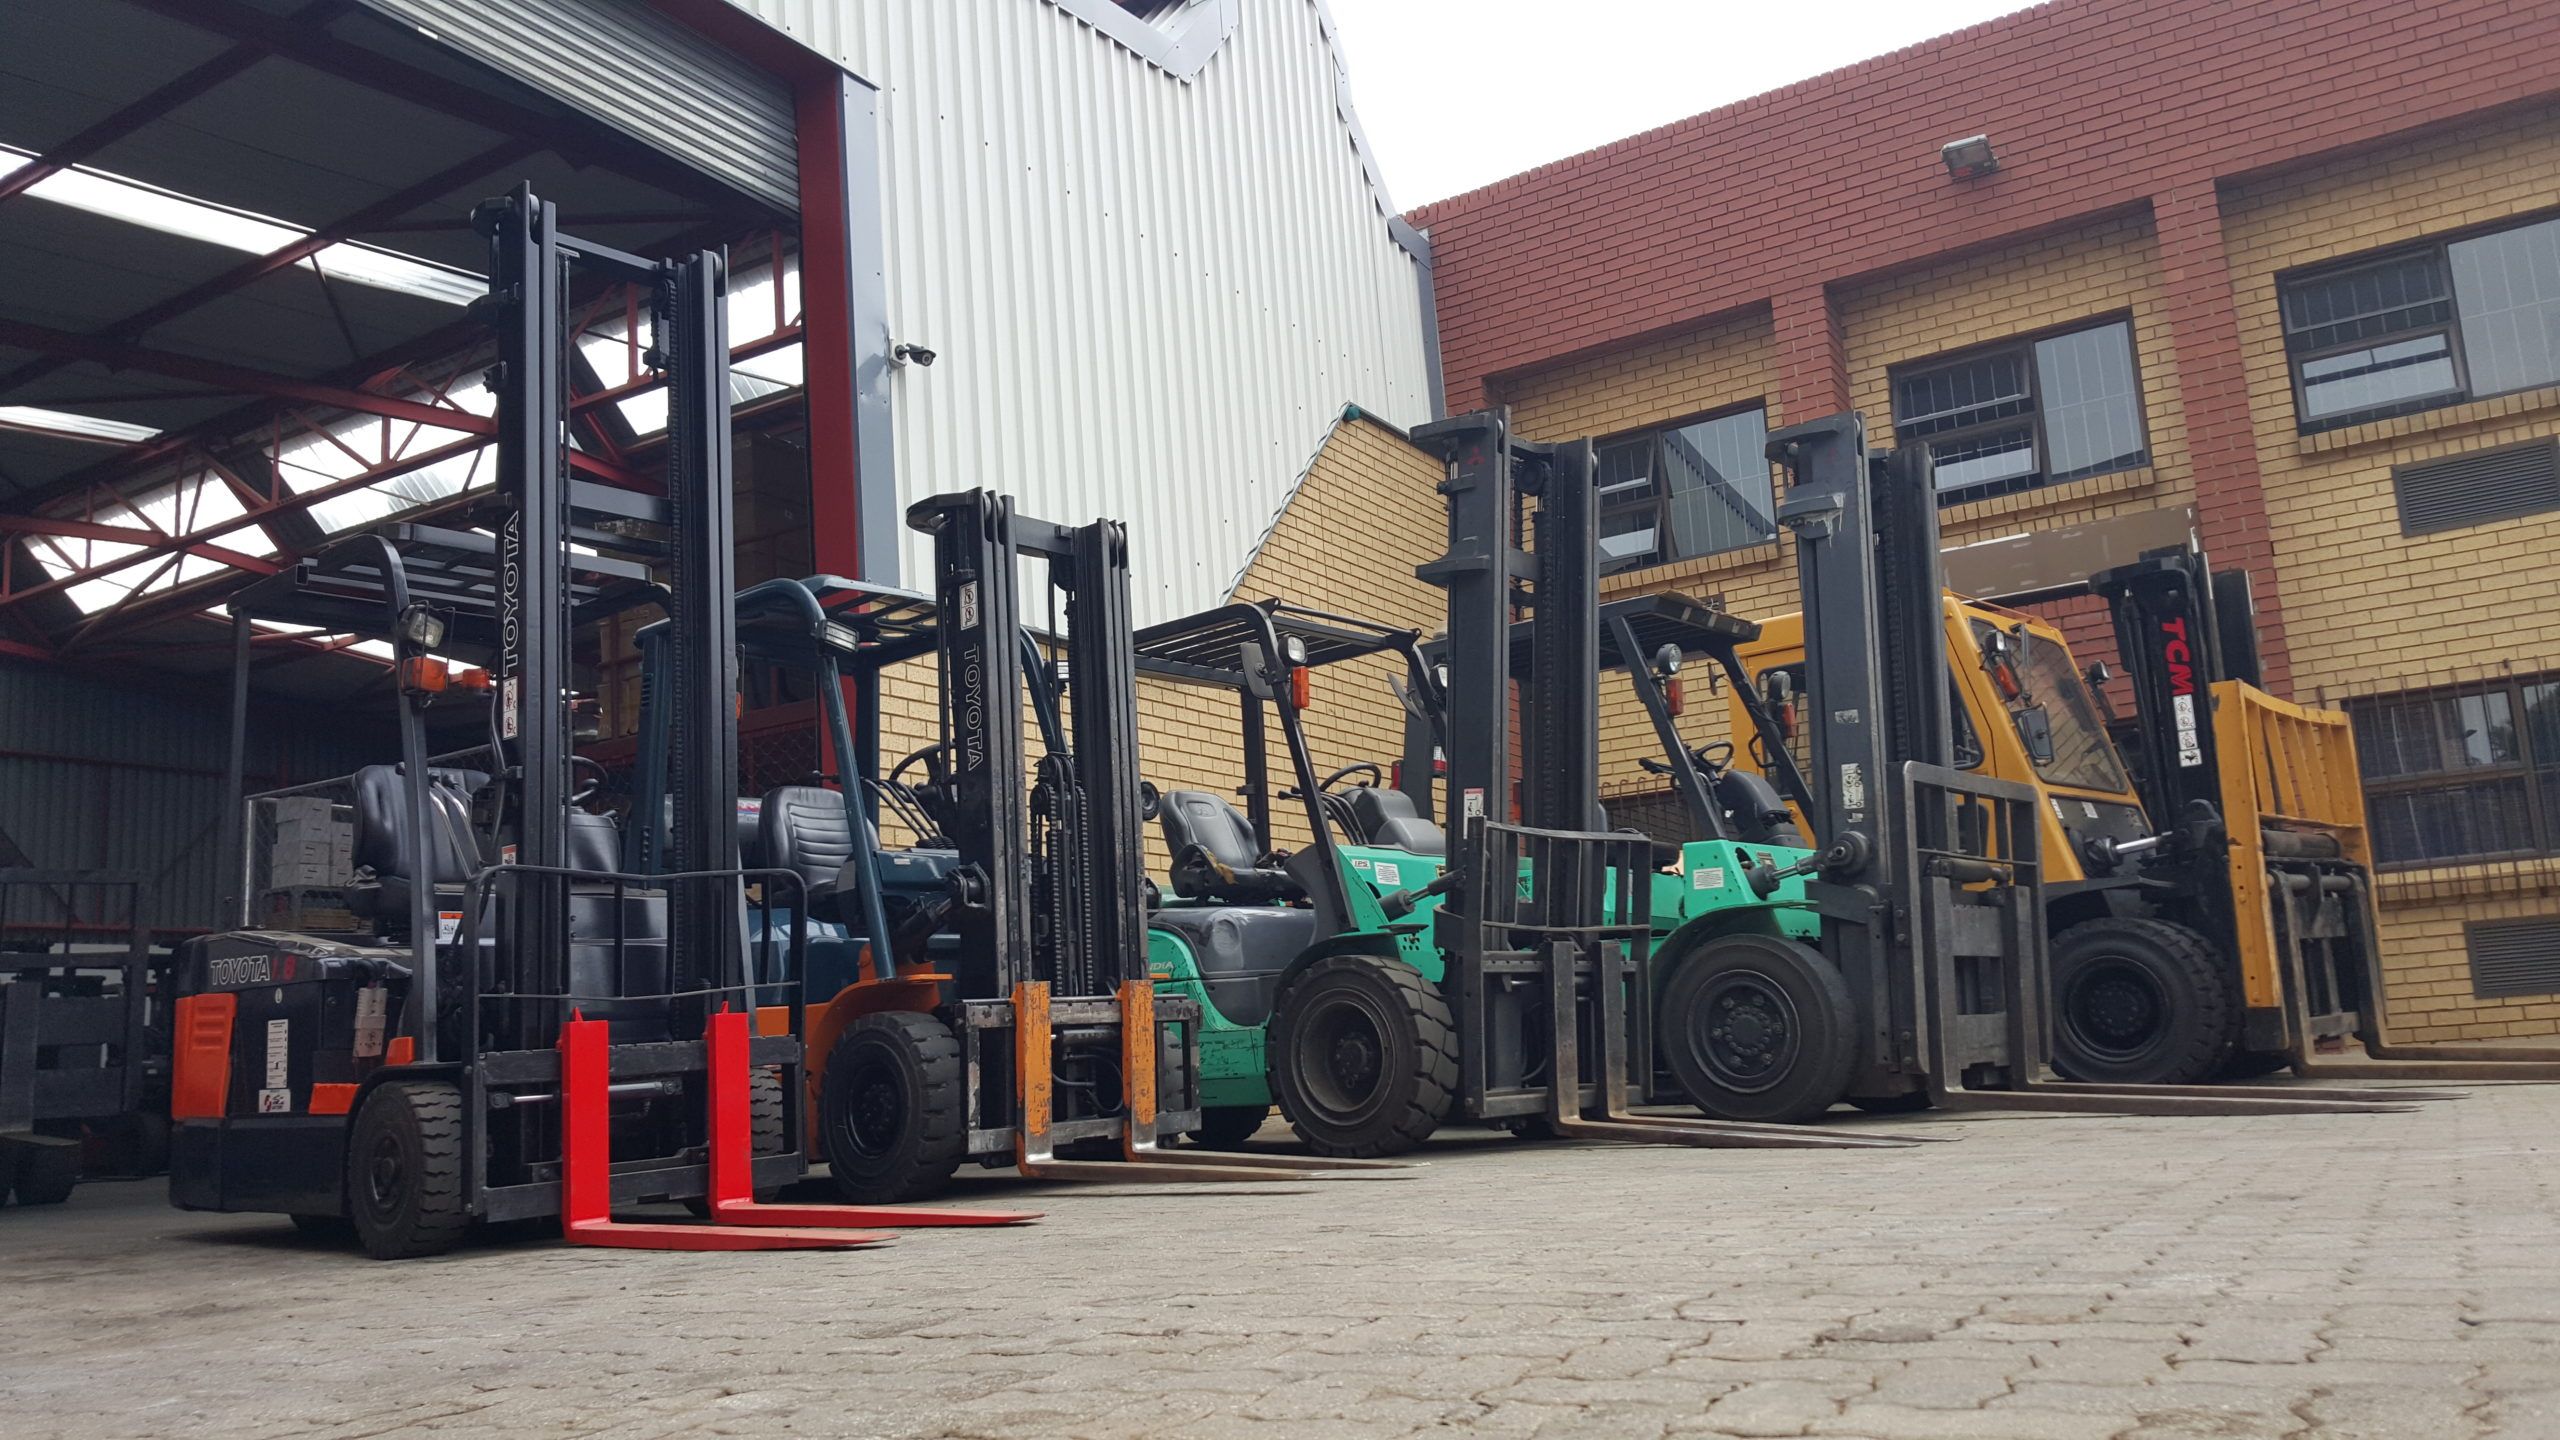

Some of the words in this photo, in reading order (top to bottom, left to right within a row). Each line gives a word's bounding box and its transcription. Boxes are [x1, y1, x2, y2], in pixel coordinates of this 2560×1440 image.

[503, 510, 519, 677] TOYOTA
[964, 643, 983, 771] TOYOTA
[2162, 617, 2194, 695] TCM
[210, 955, 270, 985] TOYOTA
